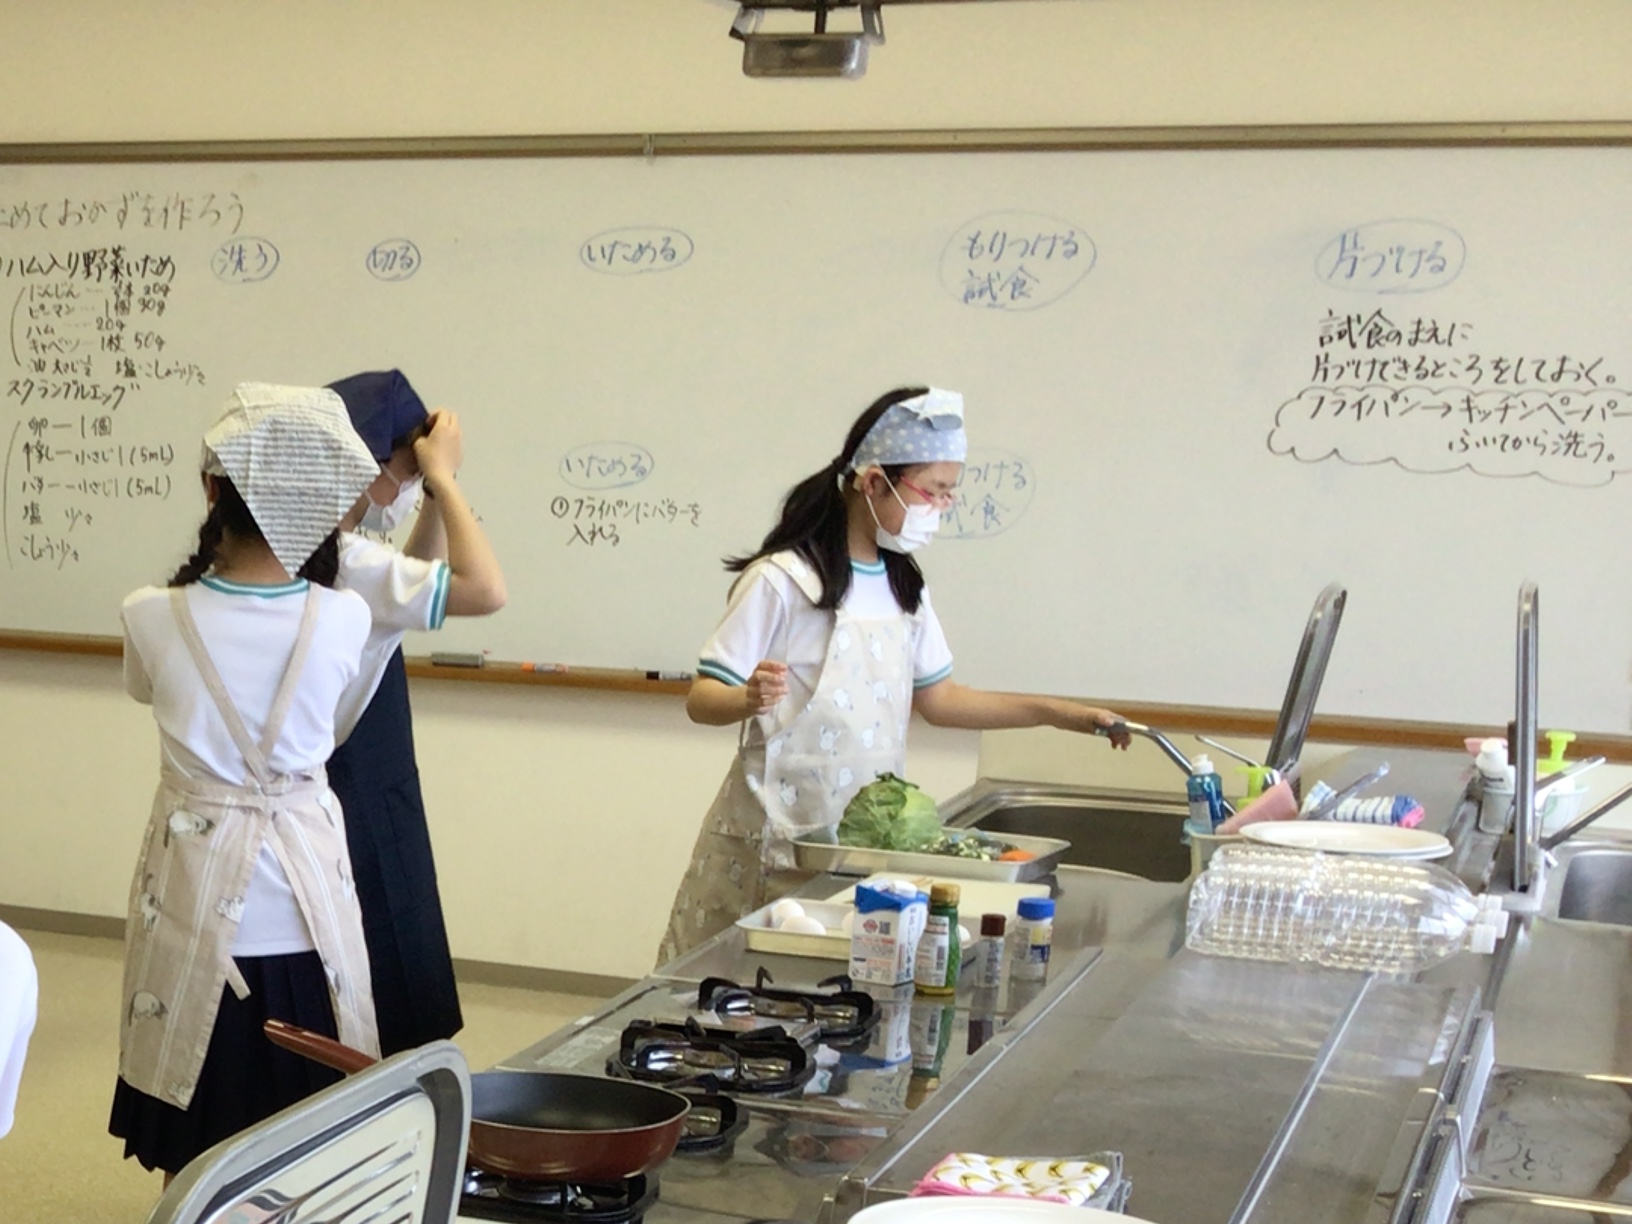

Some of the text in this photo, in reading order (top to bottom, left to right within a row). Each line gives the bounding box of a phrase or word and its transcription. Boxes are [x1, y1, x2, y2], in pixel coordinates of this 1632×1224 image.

[216, 242, 272, 276] 洗う
[369, 242, 414, 275] 切る
[585, 234, 679, 265] いためる
[1326, 232, 1449, 281] 片づける
[26, 324, 55, 339] ハム
[1317, 307, 1474, 350] 試食のまえに
[565, 453, 648, 479] いためる
